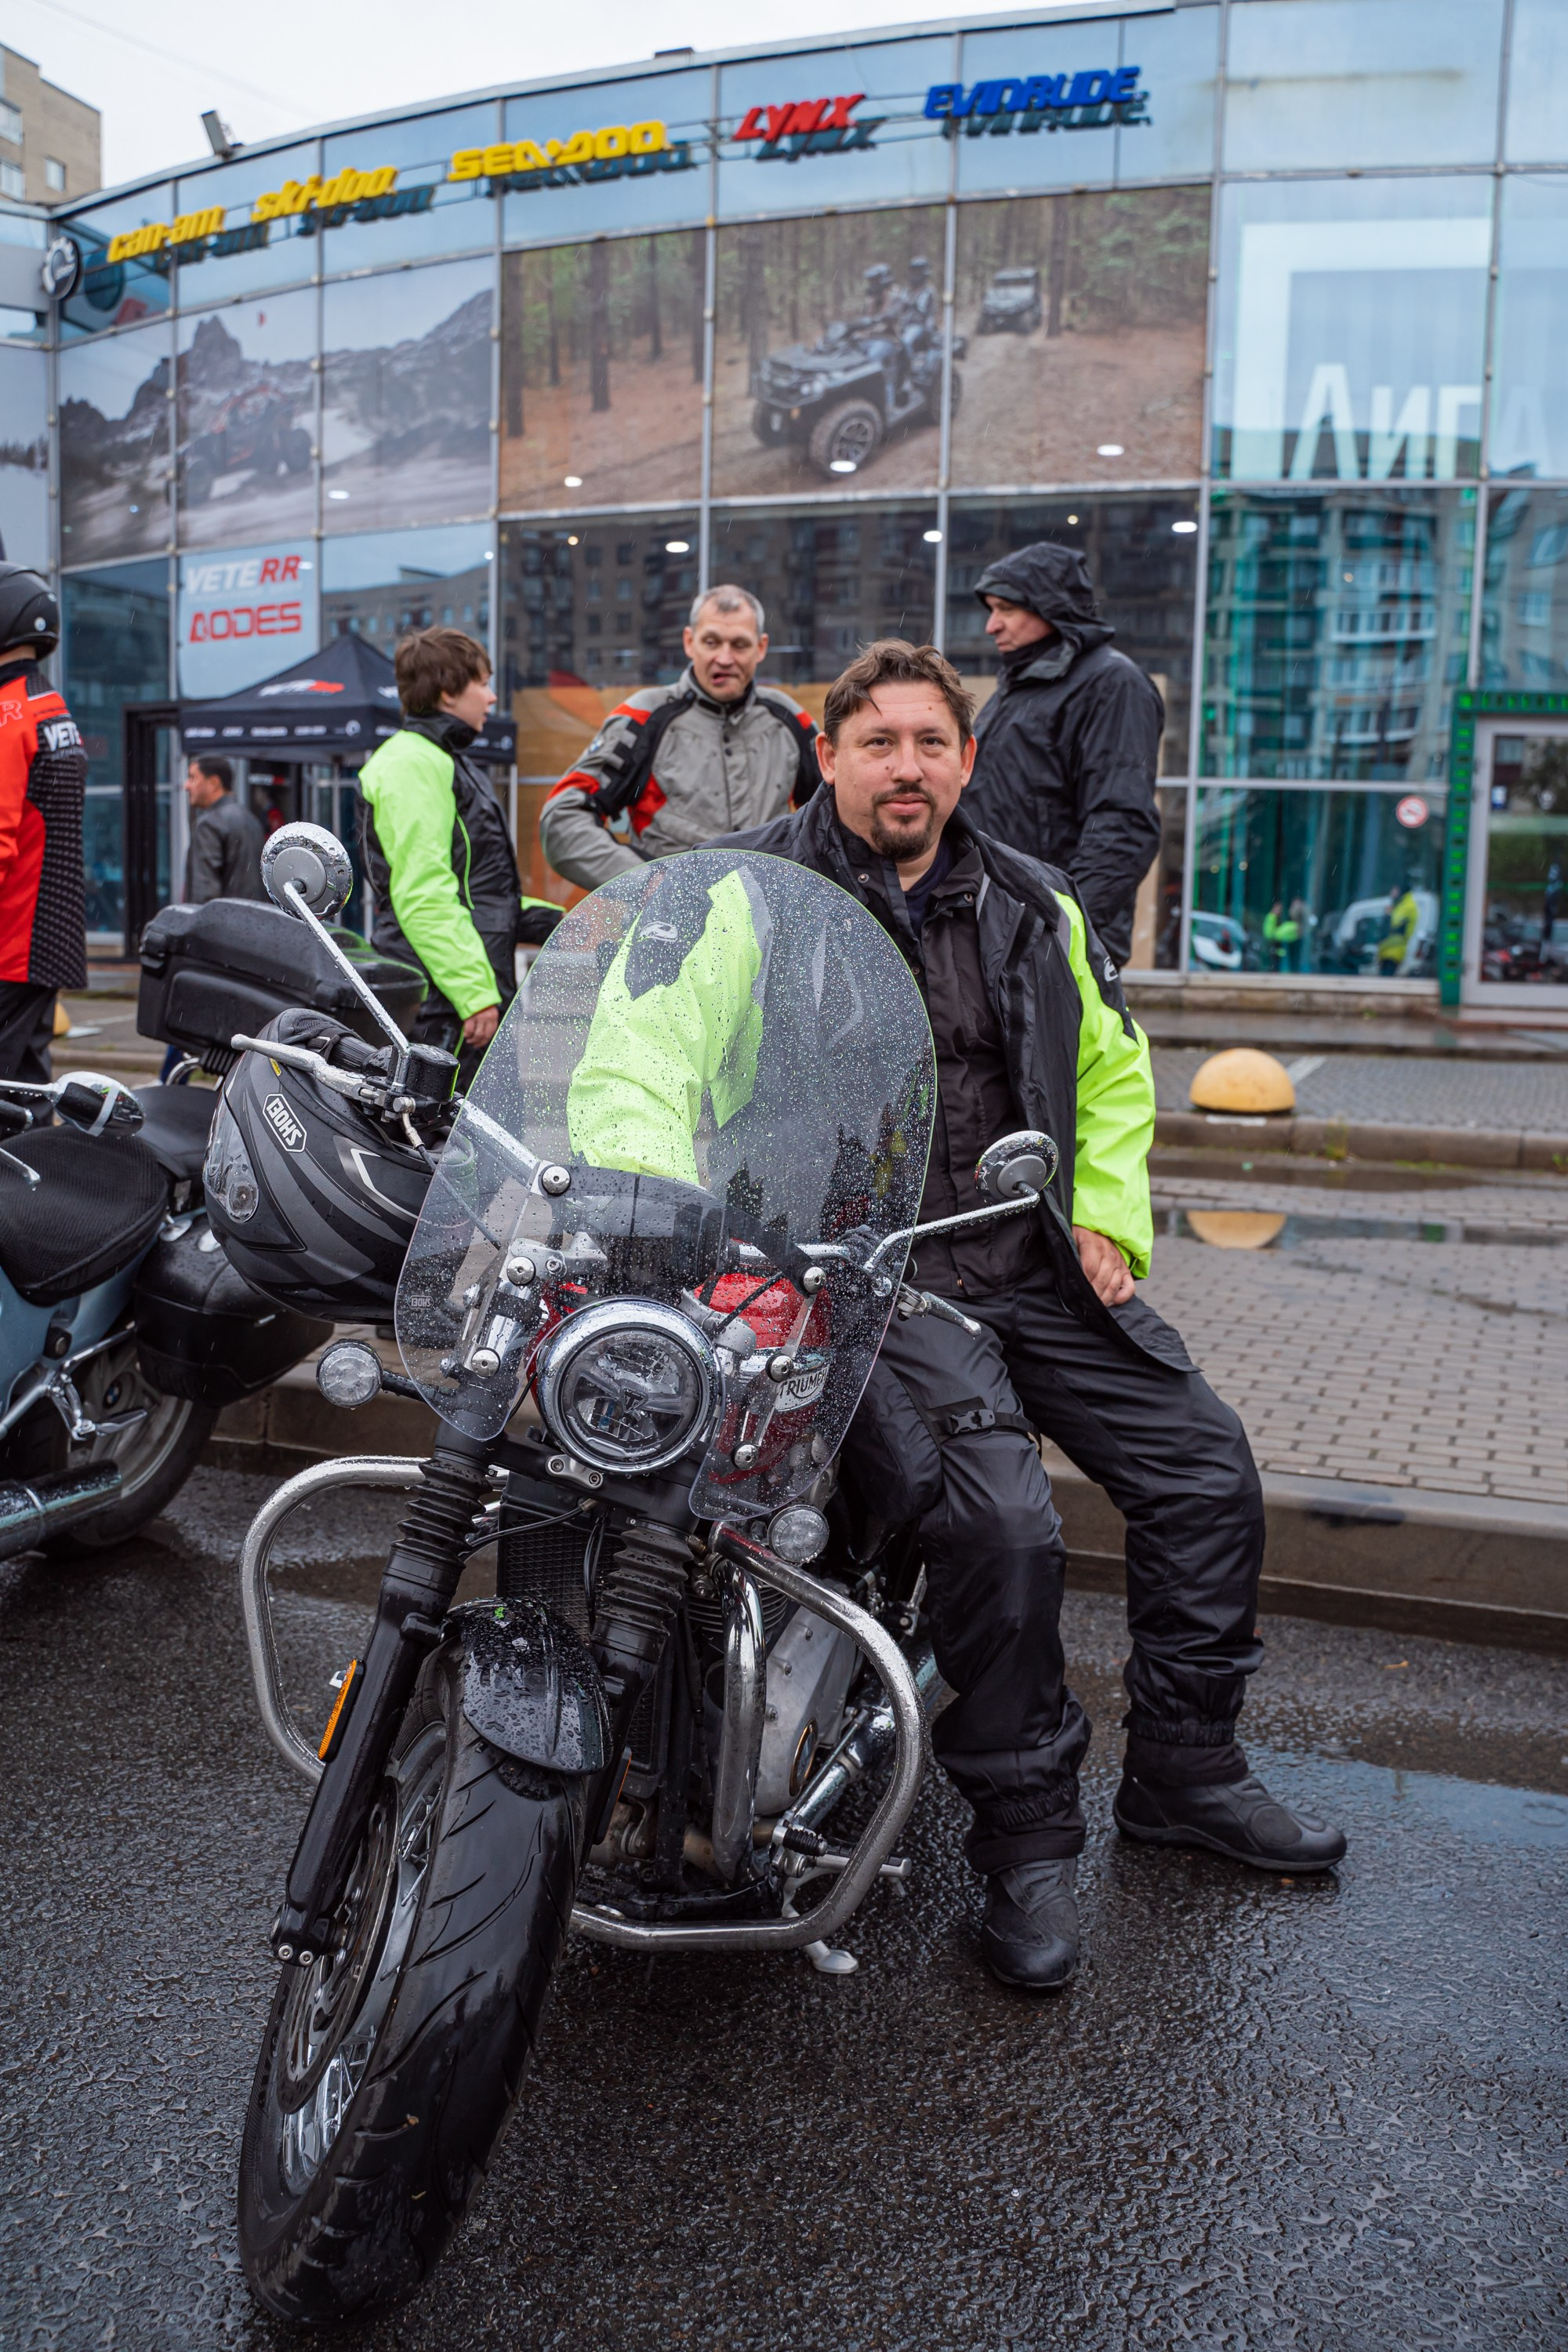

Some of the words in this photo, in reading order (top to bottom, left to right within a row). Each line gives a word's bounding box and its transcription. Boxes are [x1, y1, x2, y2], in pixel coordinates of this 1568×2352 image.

[732, 93, 866, 143] LYNX
[924, 66, 1140, 119] EVINRUDE
[187, 555, 302, 594] VETERR
[266, 1097, 303, 1146] SHOEI
